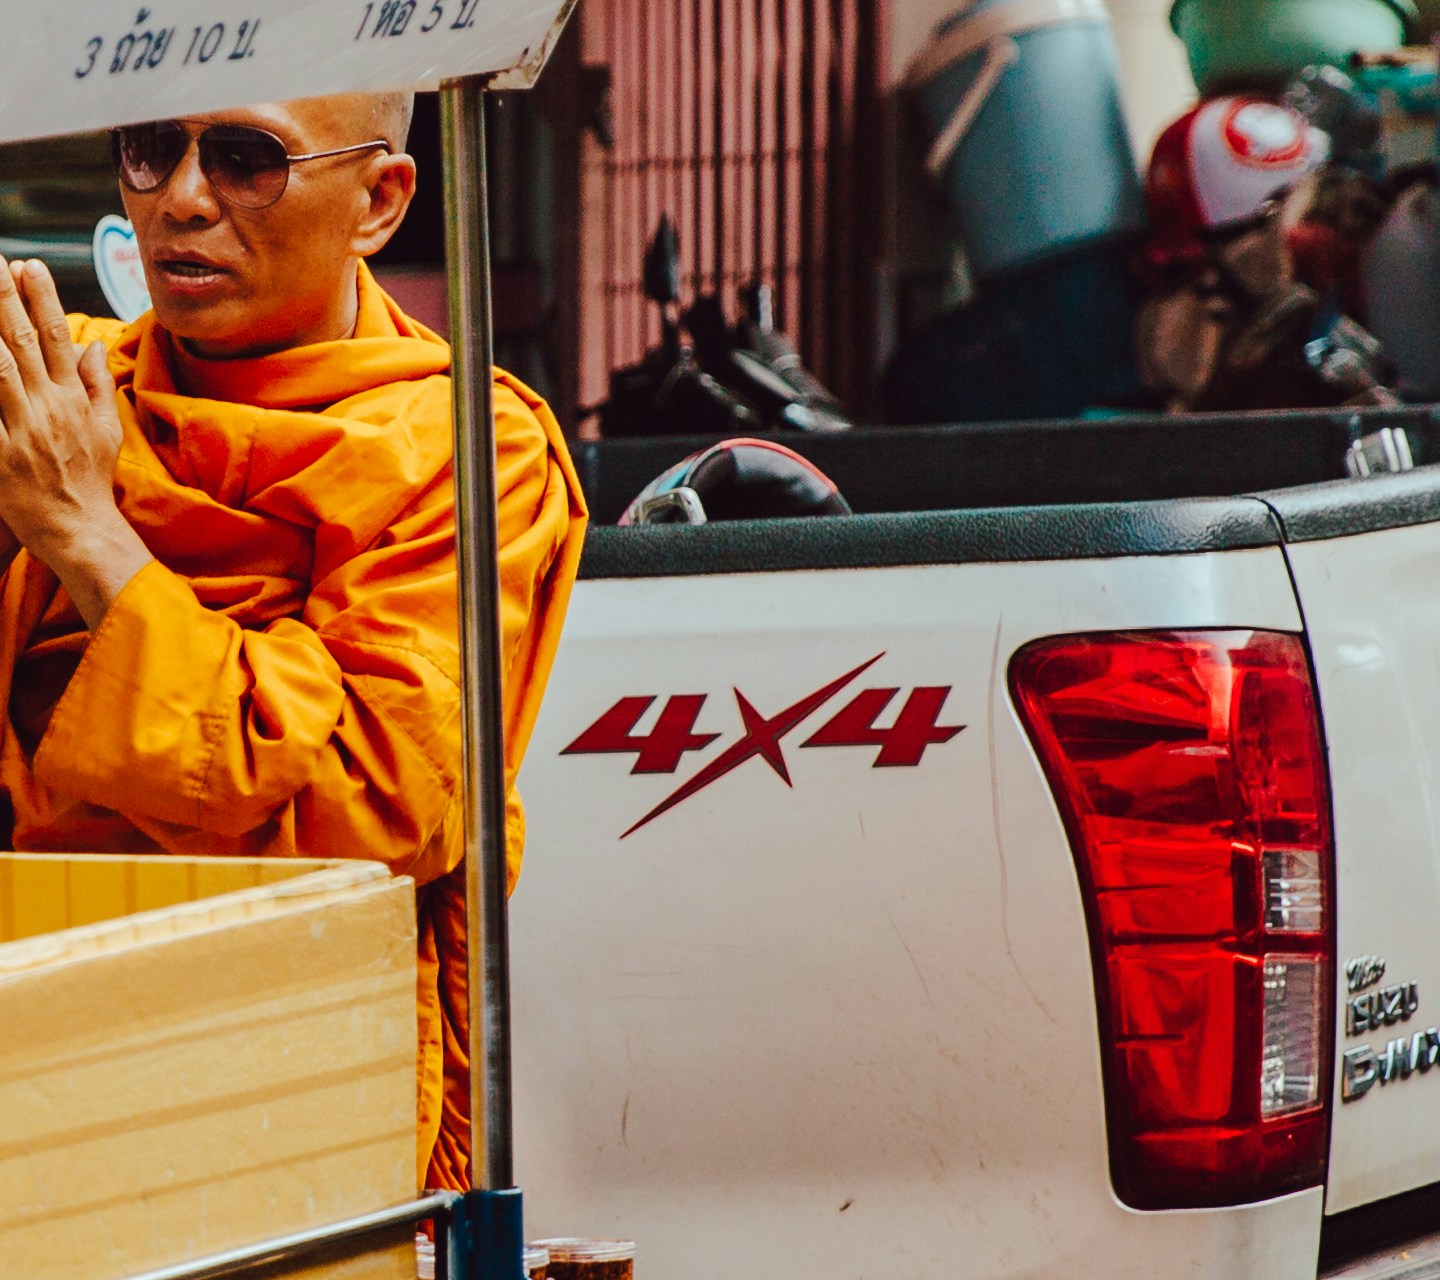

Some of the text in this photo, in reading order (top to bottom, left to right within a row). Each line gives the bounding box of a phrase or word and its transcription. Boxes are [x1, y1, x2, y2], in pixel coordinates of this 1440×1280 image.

[74, 7, 260, 79] 3 ถ้วย 10 บ.
